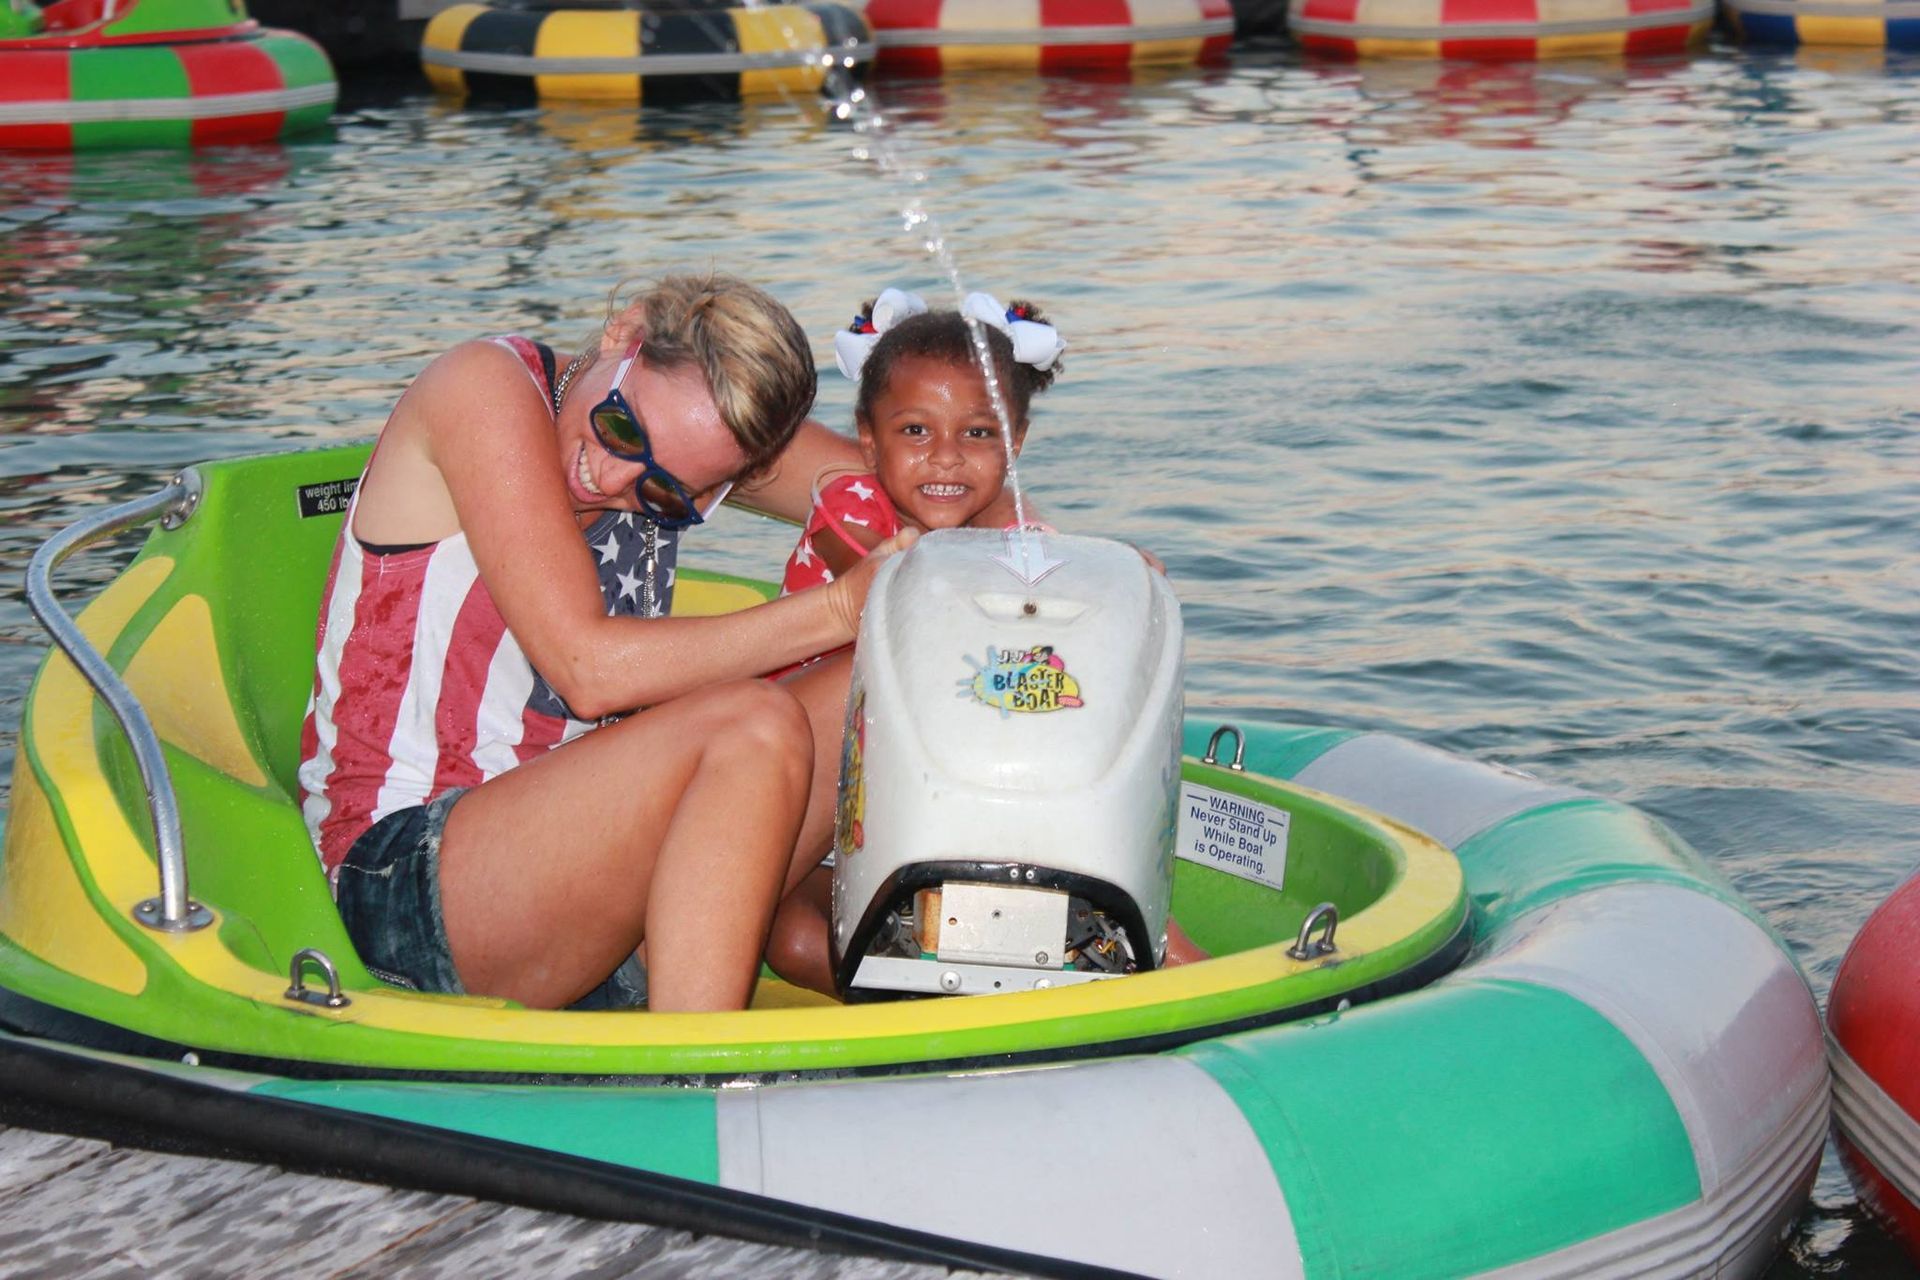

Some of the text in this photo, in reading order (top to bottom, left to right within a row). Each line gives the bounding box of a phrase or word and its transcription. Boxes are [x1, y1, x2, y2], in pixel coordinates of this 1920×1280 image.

[305, 483, 341, 498] weight
[317, 498, 337, 512] 450
[993, 669, 1065, 691] BLASTER
[1013, 690, 1062, 710] BOAT
[1210, 796, 1265, 824] WARNING
[1190, 806, 1277, 845] Never Stand Up
[1204, 826, 1263, 856] While Boat
[1194, 840, 1265, 875] is Operating.
